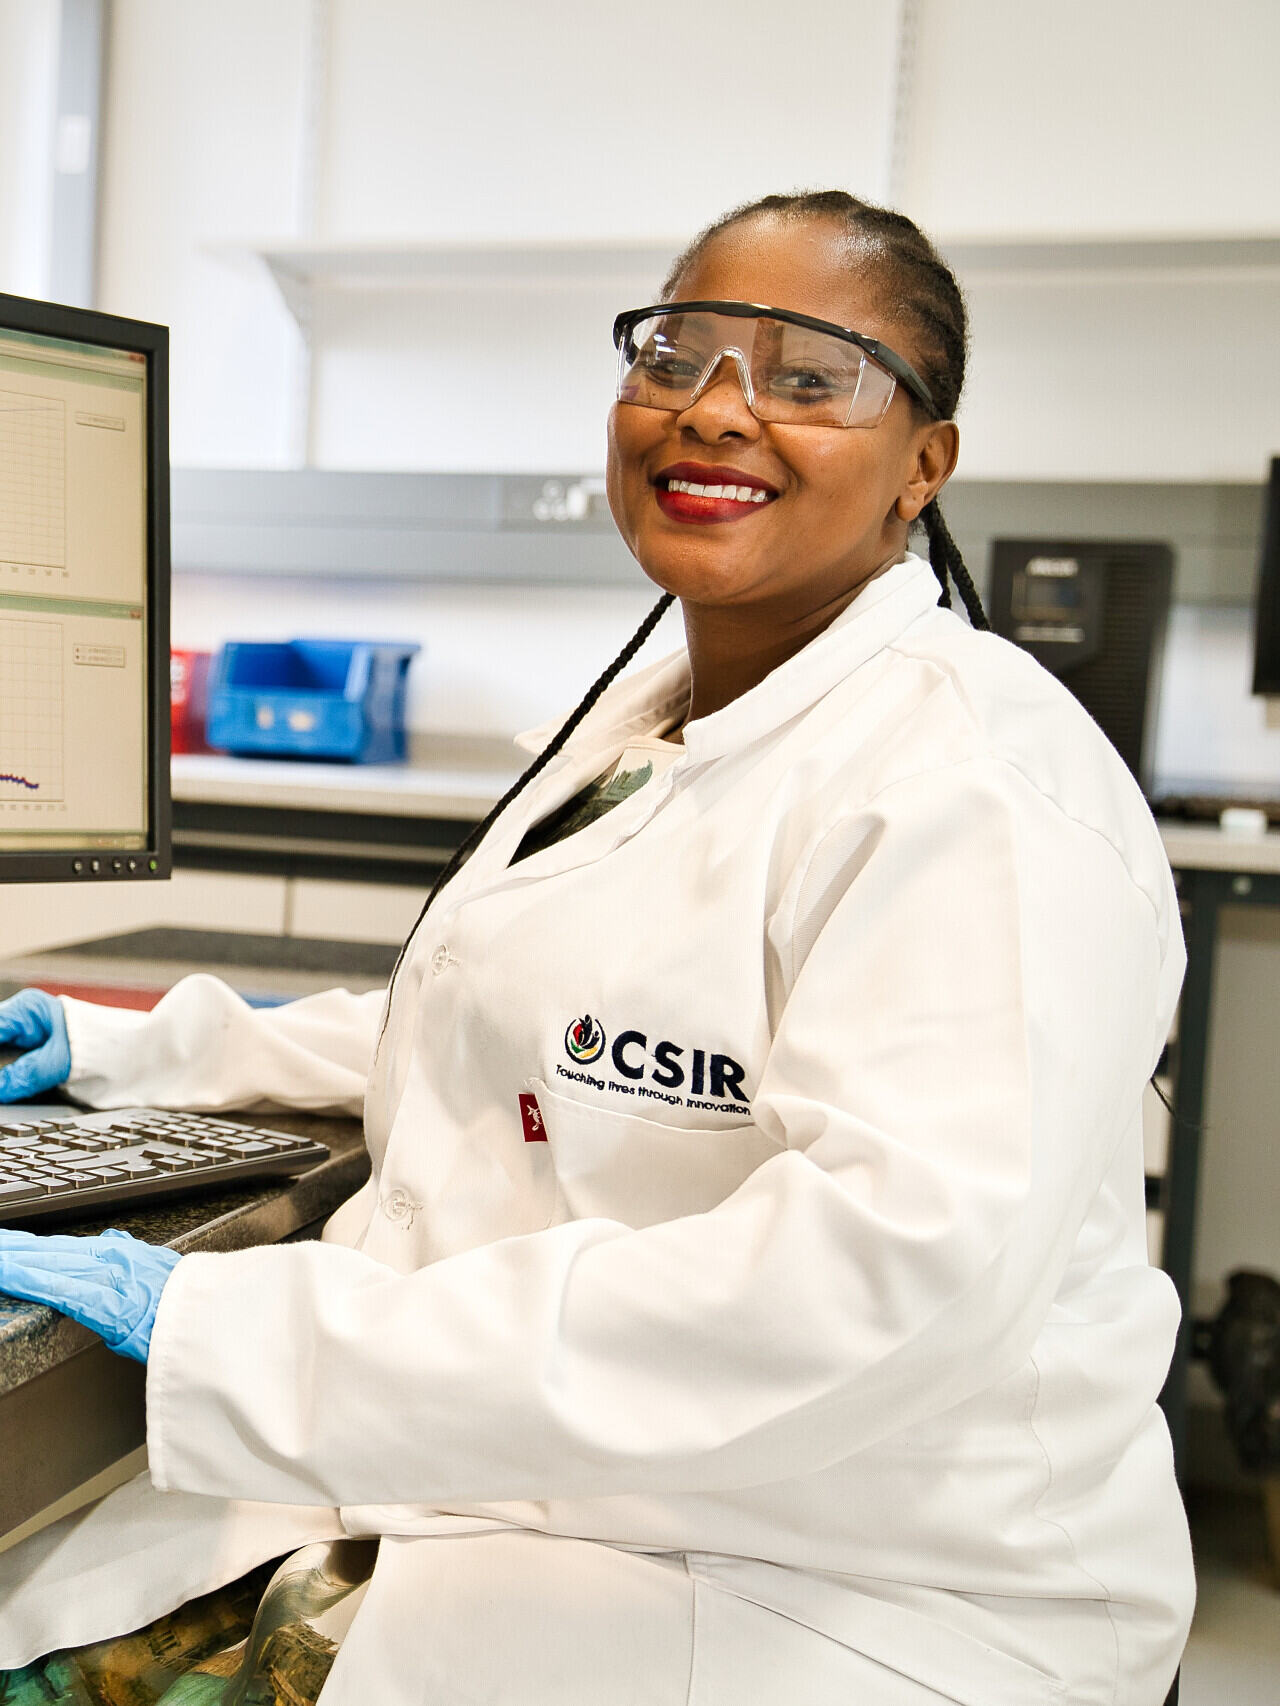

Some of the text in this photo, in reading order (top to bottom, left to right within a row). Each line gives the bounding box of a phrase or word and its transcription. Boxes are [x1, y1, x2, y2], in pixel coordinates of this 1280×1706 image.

[555, 1064, 605, 1091] Touching
[608, 1081, 635, 1095] lives
[638, 1086, 683, 1105] through
[611, 1030, 750, 1103] CSIR
